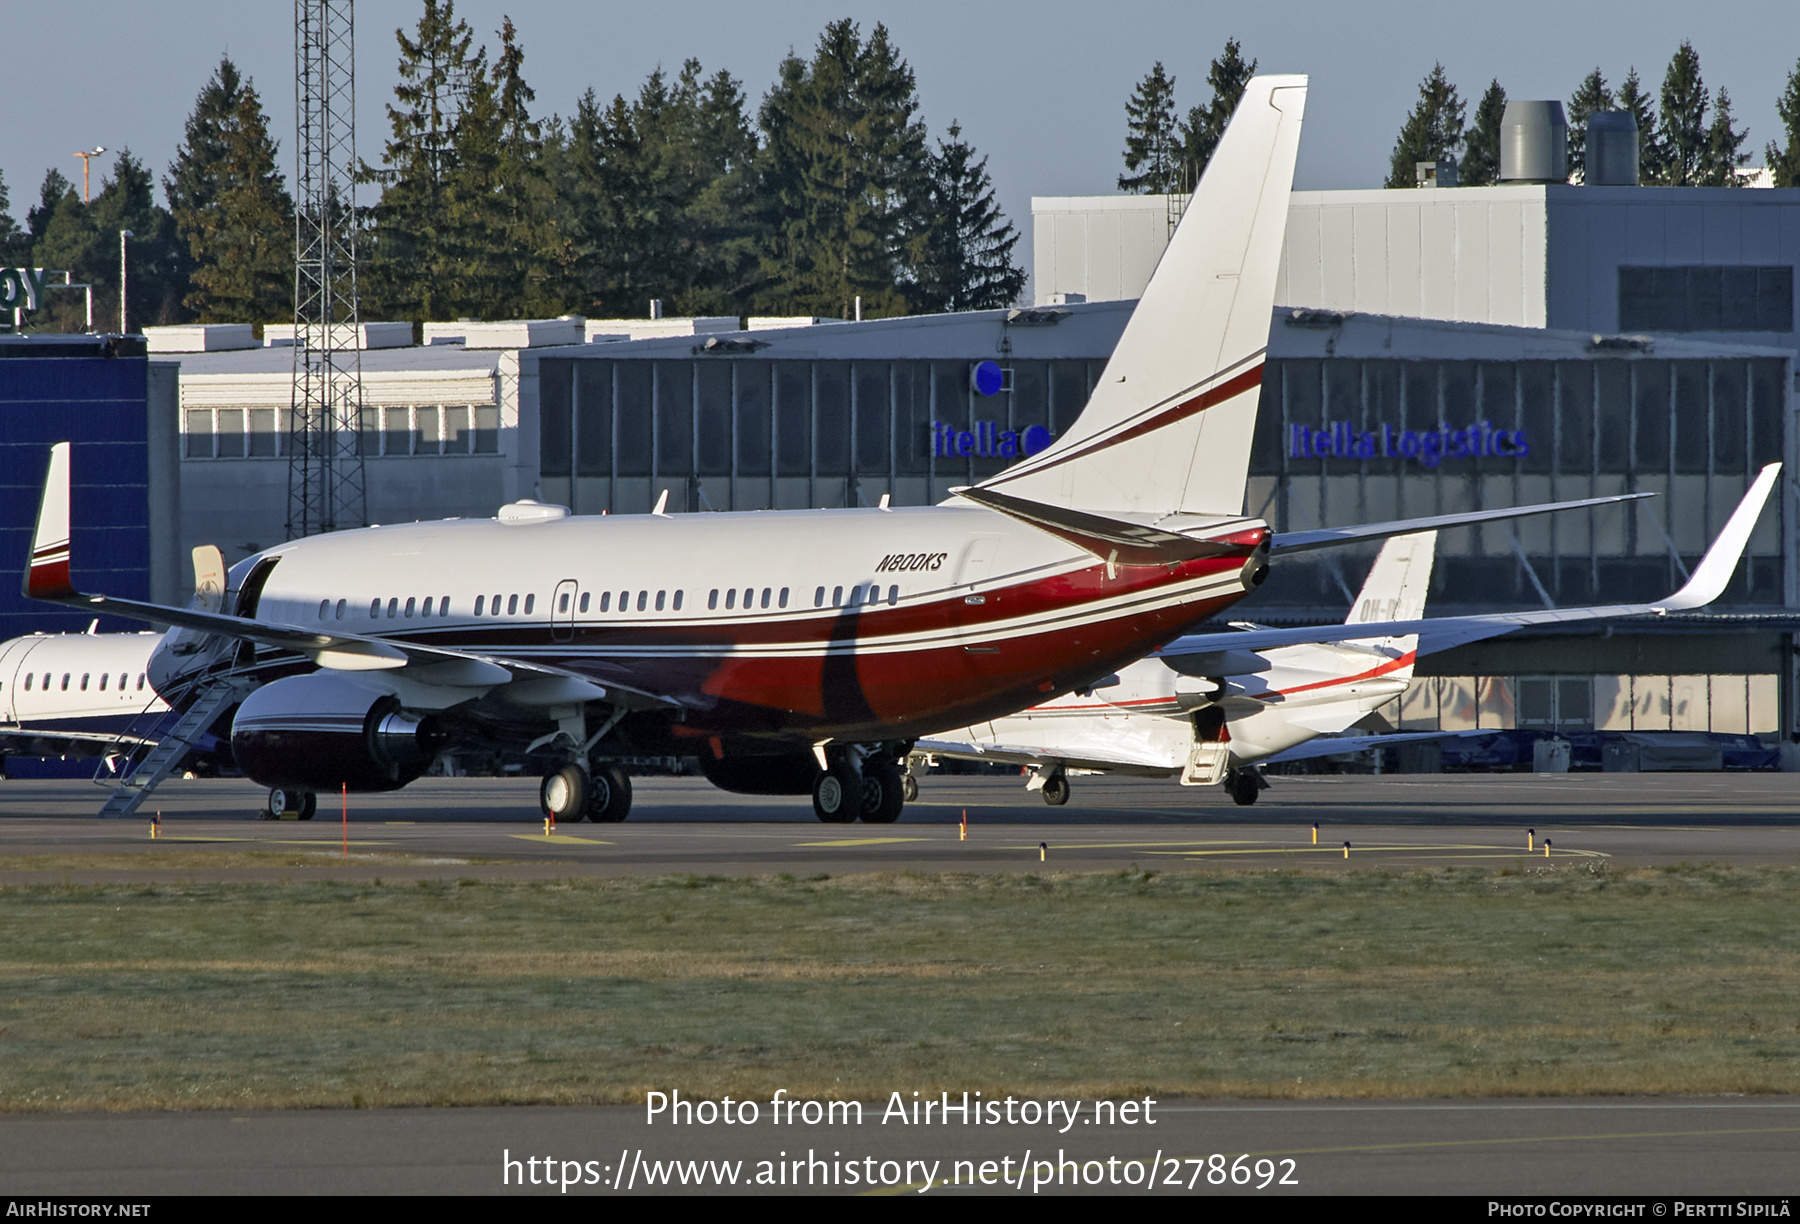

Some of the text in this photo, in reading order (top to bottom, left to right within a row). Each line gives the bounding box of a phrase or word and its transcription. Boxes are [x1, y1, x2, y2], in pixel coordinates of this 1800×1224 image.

[929, 420, 1018, 459] itella
[1289, 420, 1531, 468] Itella Logistics
[875, 552, 949, 574] N800KS
